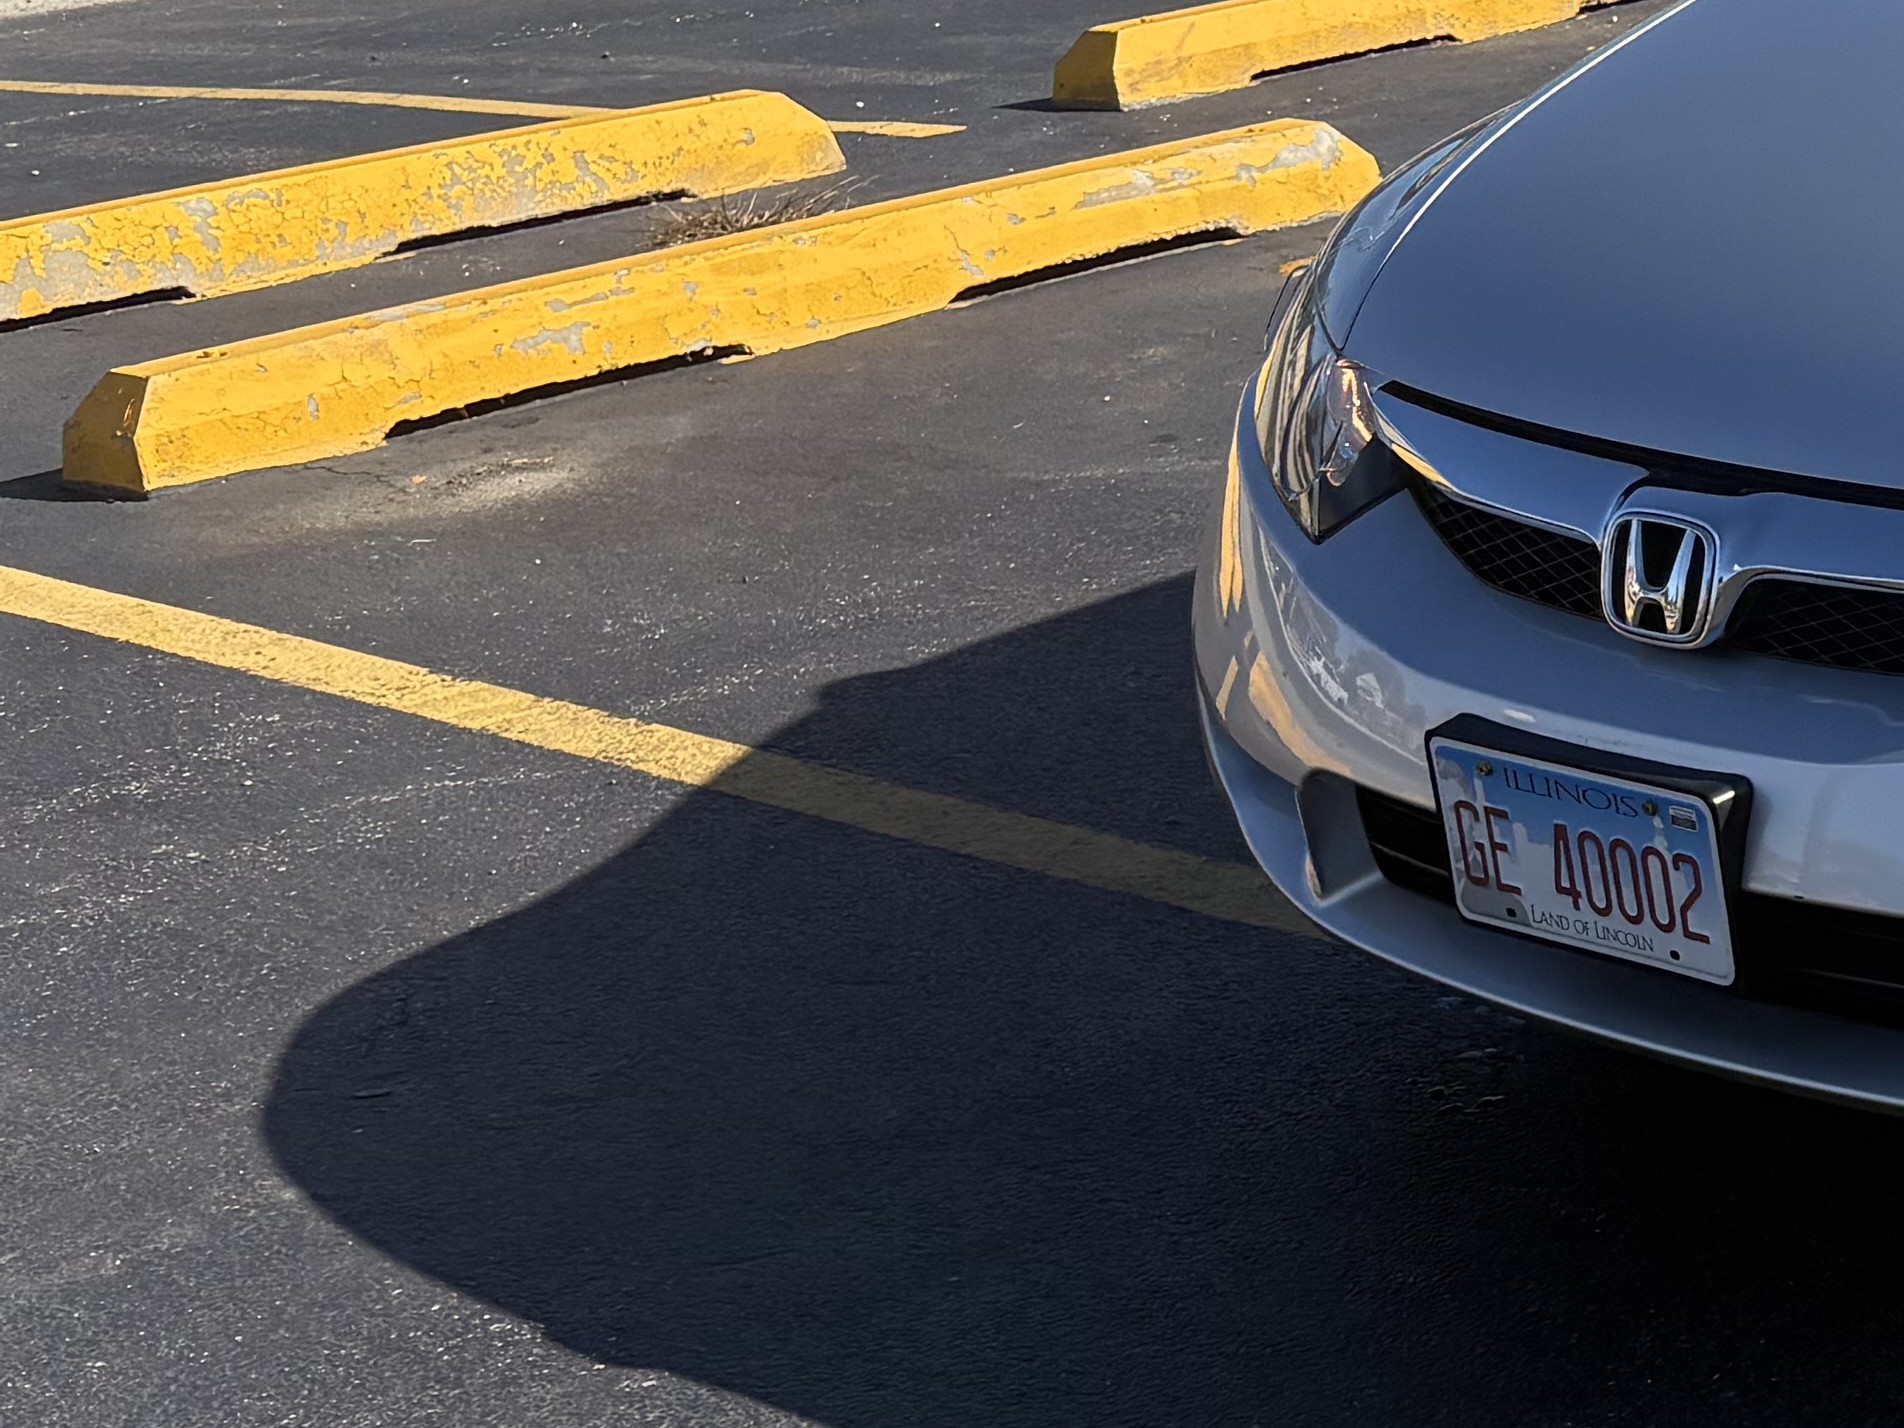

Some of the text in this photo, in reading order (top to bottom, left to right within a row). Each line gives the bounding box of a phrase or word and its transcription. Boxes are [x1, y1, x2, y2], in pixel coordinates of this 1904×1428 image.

[1503, 767, 1640, 819] ILLINOIS
[1453, 800, 1711, 945] GE 40002
[1530, 904, 1656, 954] LAND OF LINCOLN
